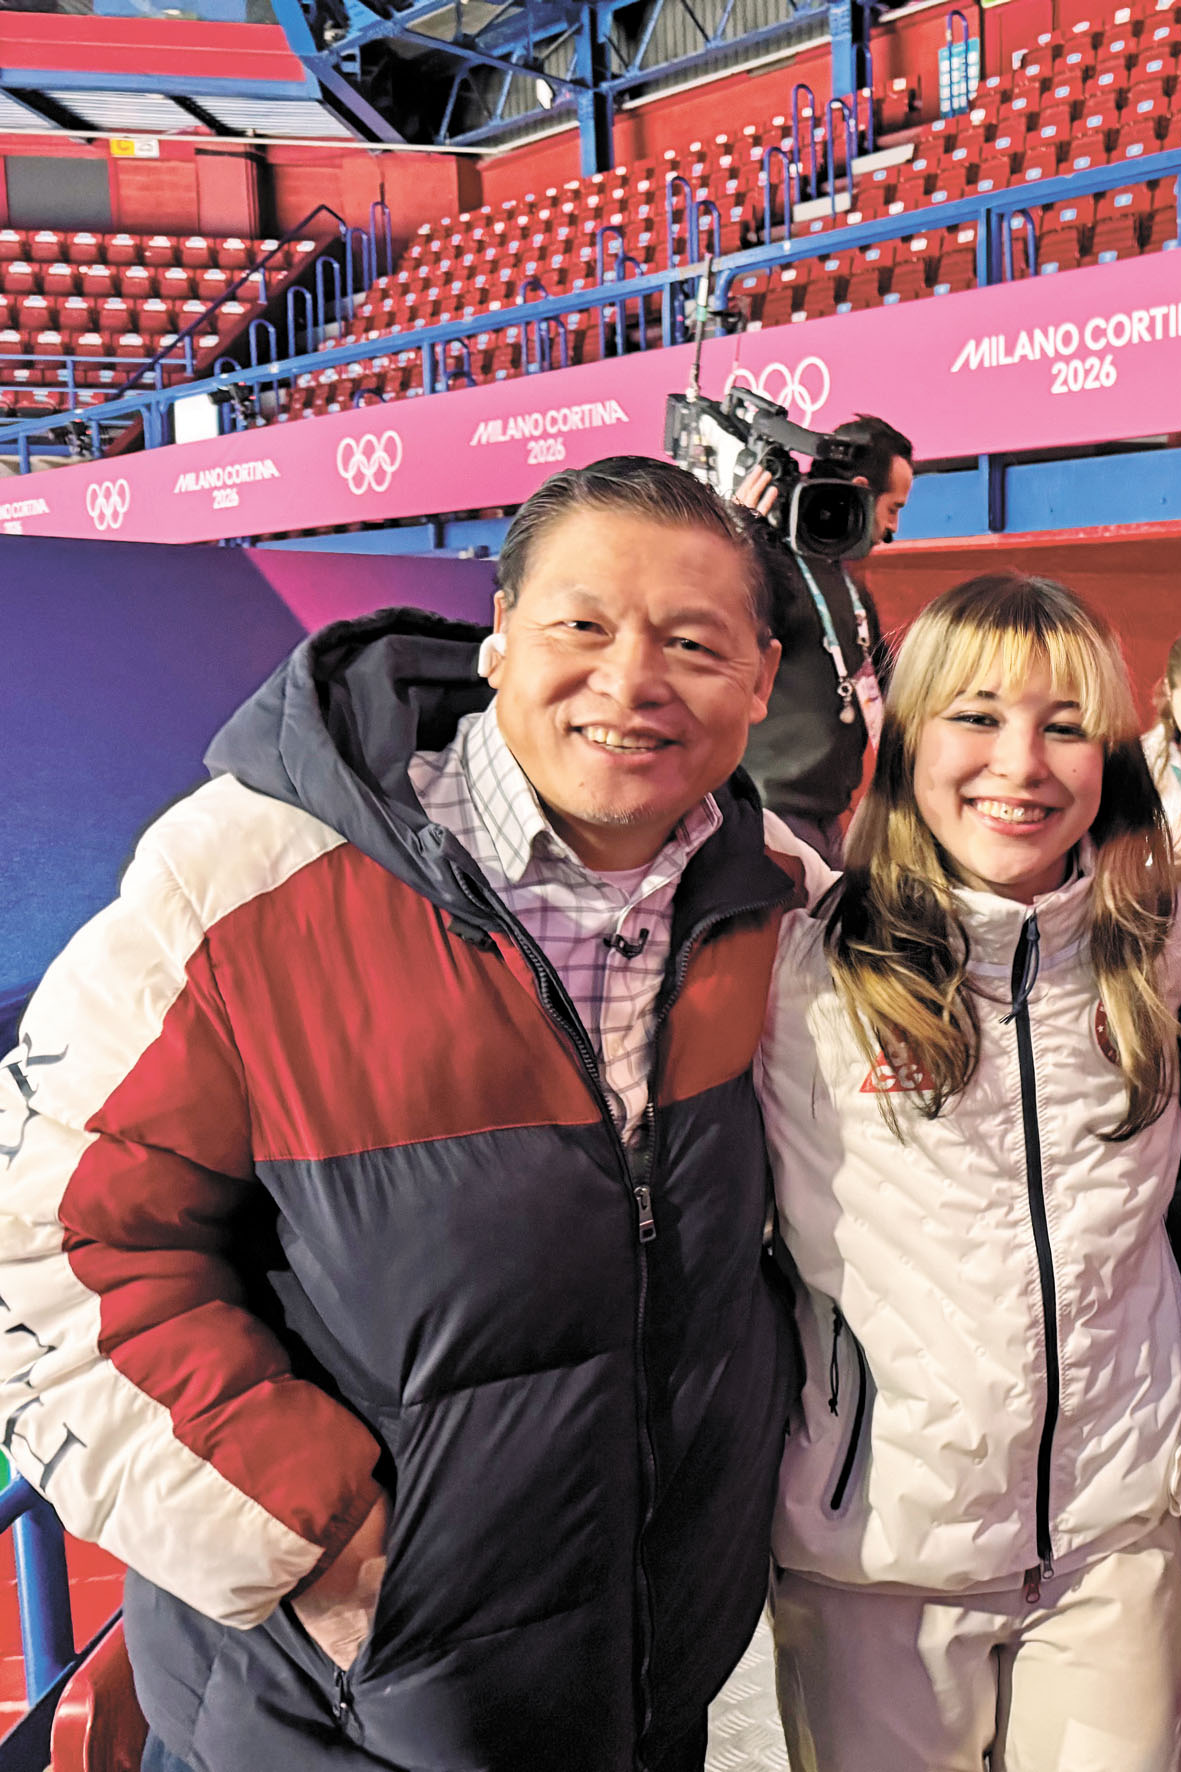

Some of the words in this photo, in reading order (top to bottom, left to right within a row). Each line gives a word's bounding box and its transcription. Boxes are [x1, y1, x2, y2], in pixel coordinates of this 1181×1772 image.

[950, 322, 1080, 373] MILANO
[1050, 354, 1117, 394] 2026
[469, 412, 543, 446] MILANO
[545, 400, 629, 434] CORTINA
[527, 437, 566, 464] 2026
[173, 467, 223, 494] MILANO
[224, 459, 280, 485] CORTINA
